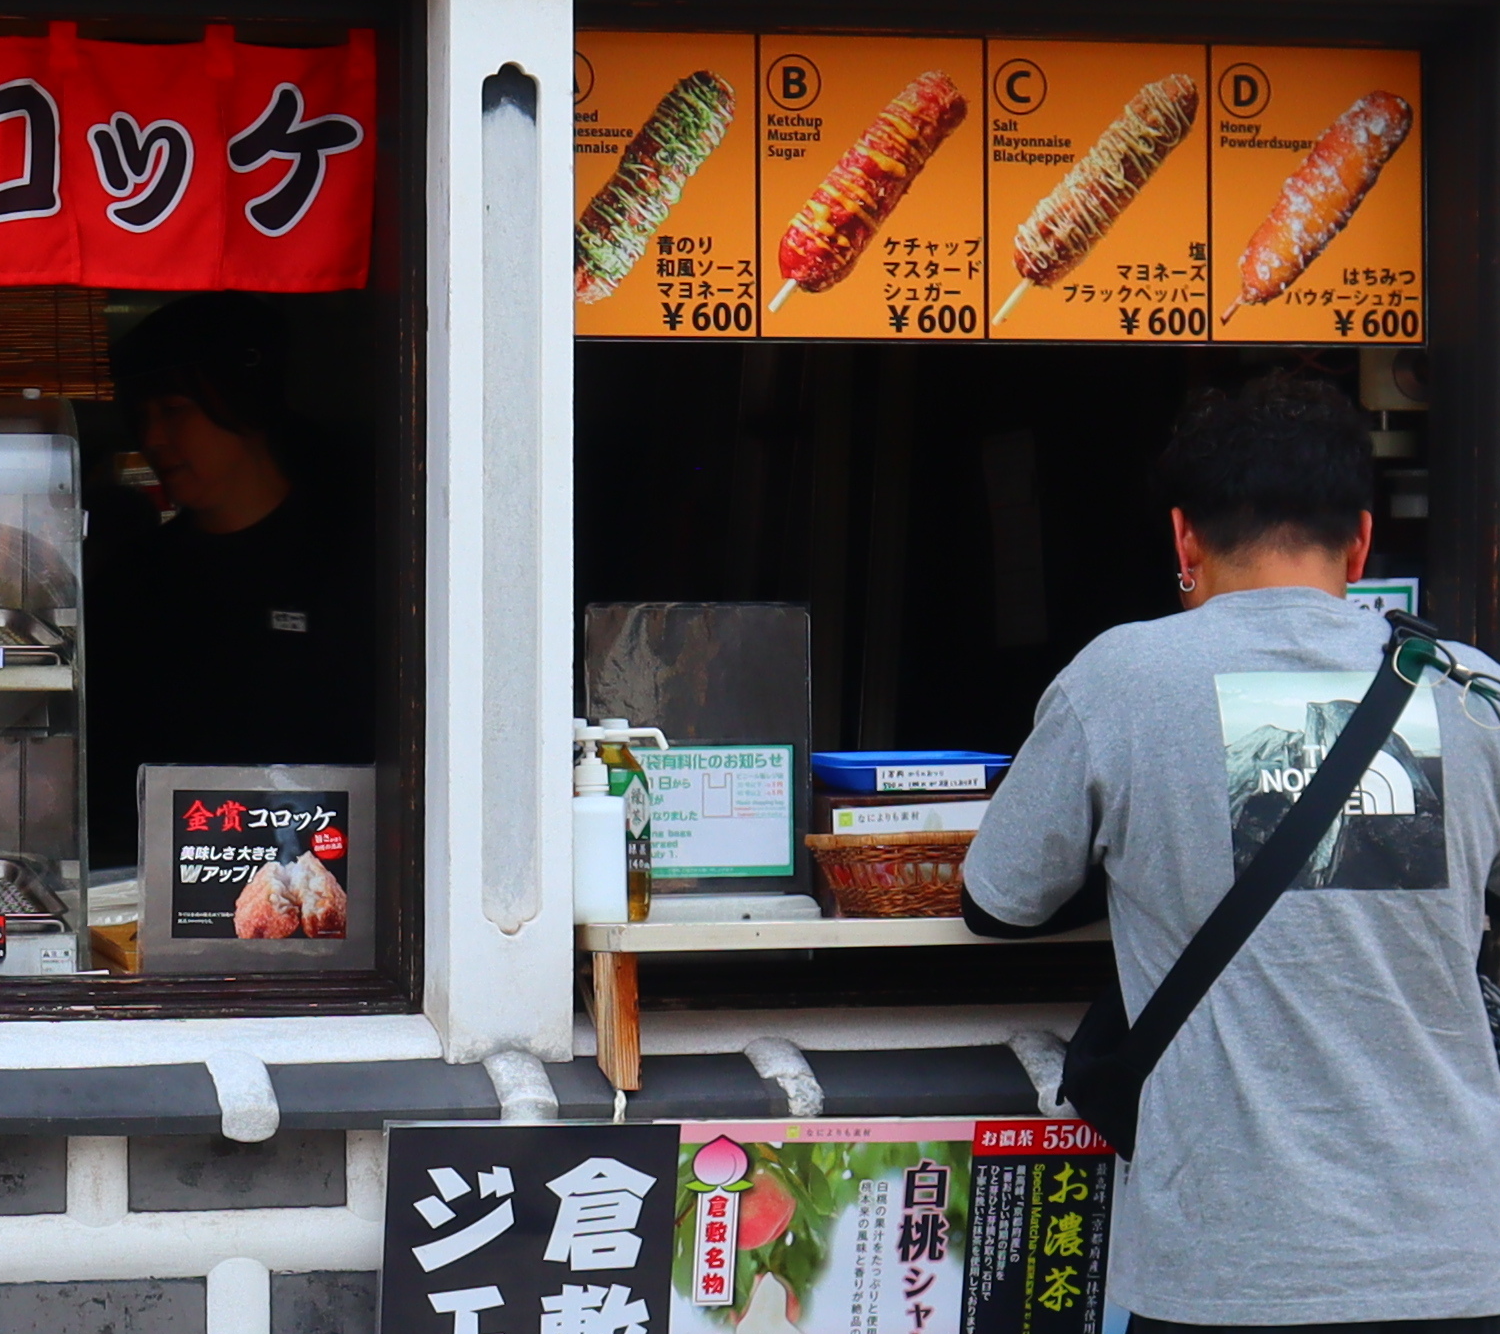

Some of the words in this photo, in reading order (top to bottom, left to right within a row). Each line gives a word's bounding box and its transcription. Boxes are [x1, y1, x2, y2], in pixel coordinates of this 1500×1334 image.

[781, 66, 808, 99] B
[1005, 70, 1032, 104] C
[1233, 73, 1260, 107] D
[767, 114, 823, 133] Ketchup
[992, 119, 1019, 133] Salt
[1219, 120, 1262, 137] Honey
[767, 128, 821, 143] Mustard
[992, 134, 1072, 150] Mayonnaise
[767, 145, 807, 160] Sugar
[992, 149, 1075, 165] Blackpepper
[656, 235, 713, 255] 青のり
[882, 236, 982, 257] ケチャップ
[1188, 241, 1206, 260] 塩
[656, 260, 755, 279] 和風ソース
[882, 260, 983, 280] マスタード
[1115, 264, 1206, 282] マヨネーズ
[1342, 268, 1416, 286] はちみつ
[656, 282, 755, 301] マヨネーズ
[882, 283, 962, 303] シュガー
[1062, 284, 1206, 302] ブラックペッパー
[1285, 289, 1420, 306] パウダーシュガー
[182, 799, 338, 832] 金賞コロッケ
[980, 1128, 1035, 1147] お濃茶
[701, 1194, 730, 1295] 倉敷名物
[1037, 1160, 1090, 1312] お濃茶
